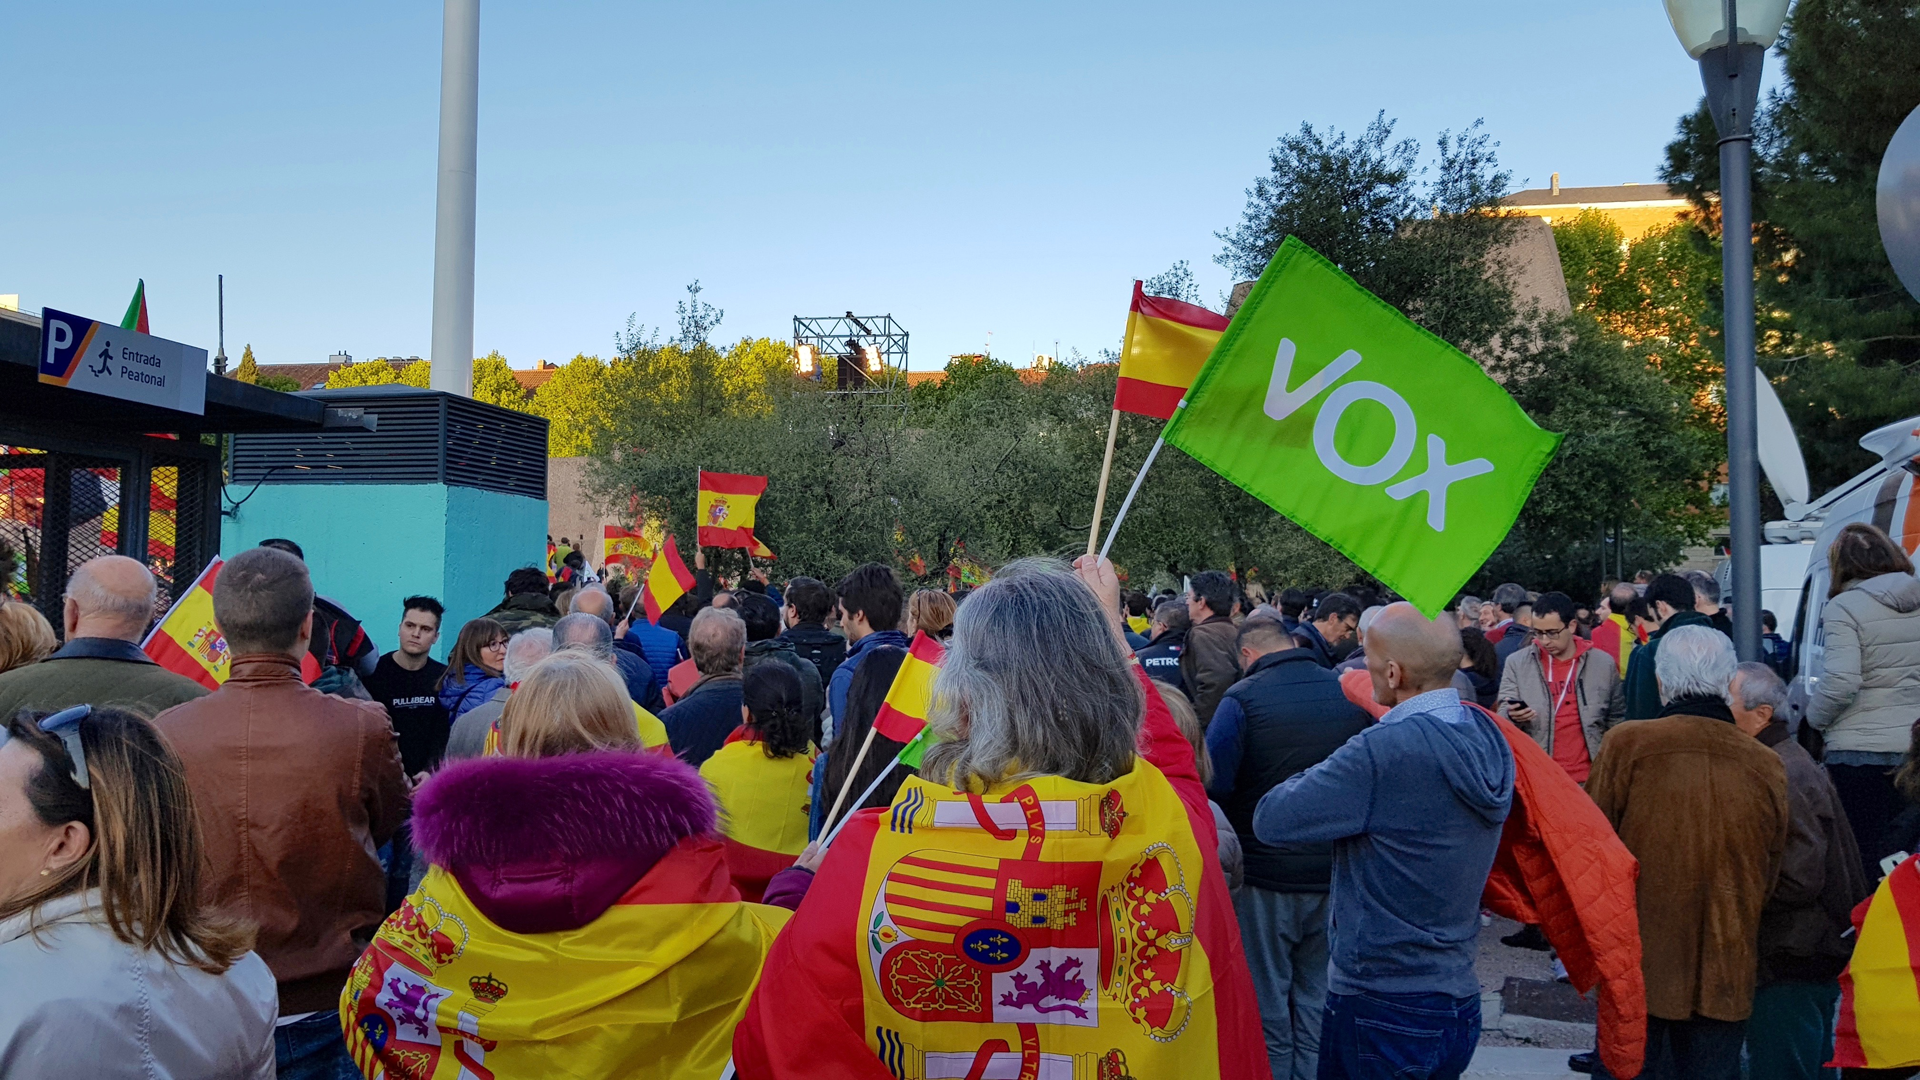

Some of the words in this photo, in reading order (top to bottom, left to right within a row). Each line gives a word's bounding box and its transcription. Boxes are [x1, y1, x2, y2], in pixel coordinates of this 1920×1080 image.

[46, 319, 73, 364] P
[122, 347, 161, 368] Entrada
[121, 365, 166, 388] Peatonal
[1263, 337, 1495, 532] VOX
[1020, 795, 1043, 844] PLVS
